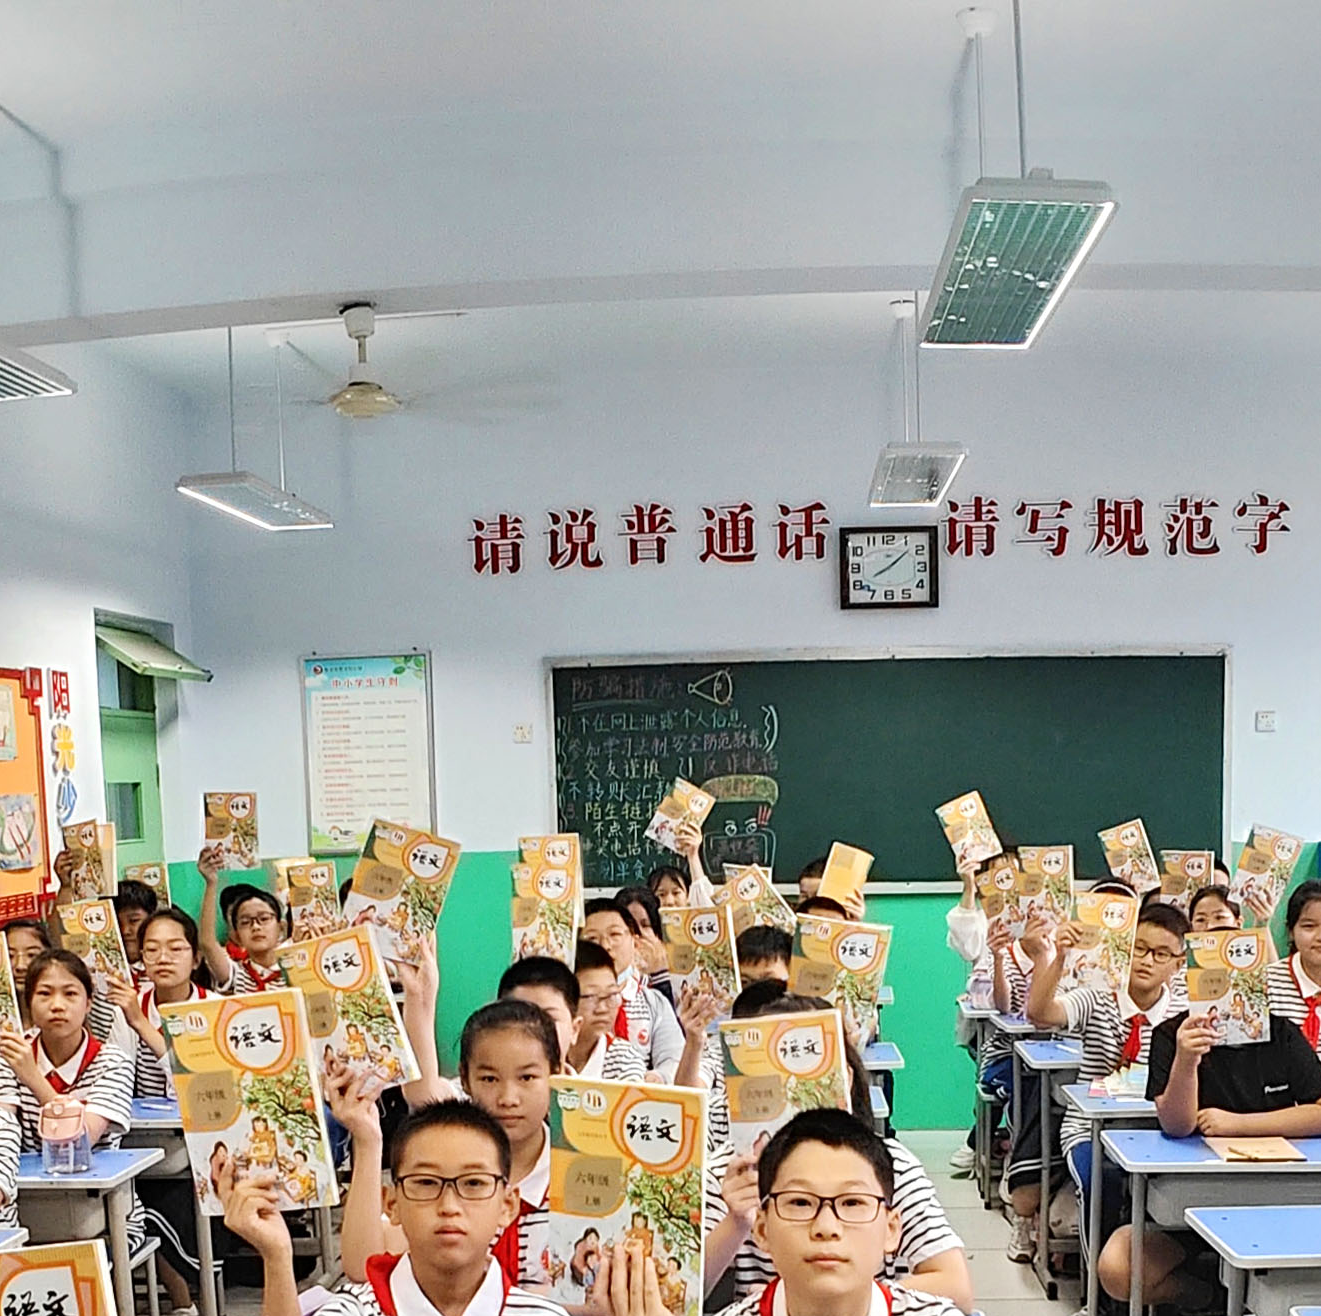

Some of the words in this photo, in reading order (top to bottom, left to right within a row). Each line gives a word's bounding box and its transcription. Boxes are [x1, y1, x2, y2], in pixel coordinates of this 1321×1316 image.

[942, 493, 1292, 560] 请写规范字
[469, 500, 832, 577] 请说普通话
[867, 536, 876, 546] 11
[882, 535, 895, 545] 12
[852, 546, 863, 557] 10
[915, 545, 925, 556] 2
[851, 563, 861, 573] 9
[917, 562, 927, 572] 3
[853, 580, 863, 590] 8
[916, 579, 925, 589] 4
[869, 590, 876, 600] 7
[902, 589, 911, 599] 5
[332, 677, 398, 688] 中小学生守则
[412, 849, 442, 869] 语文
[538, 876, 565, 889] 语文
[691, 921, 719, 935] 语文
[841, 941, 873, 959] 语文
[1229, 945, 1256, 958] 语文
[324, 950, 361, 976] 语文
[230, 1023, 282, 1049] 语文
[780, 1039, 822, 1058] 语文
[627, 1115, 680, 1144] 语文
[575, 1171, 609, 1187] 六年级
